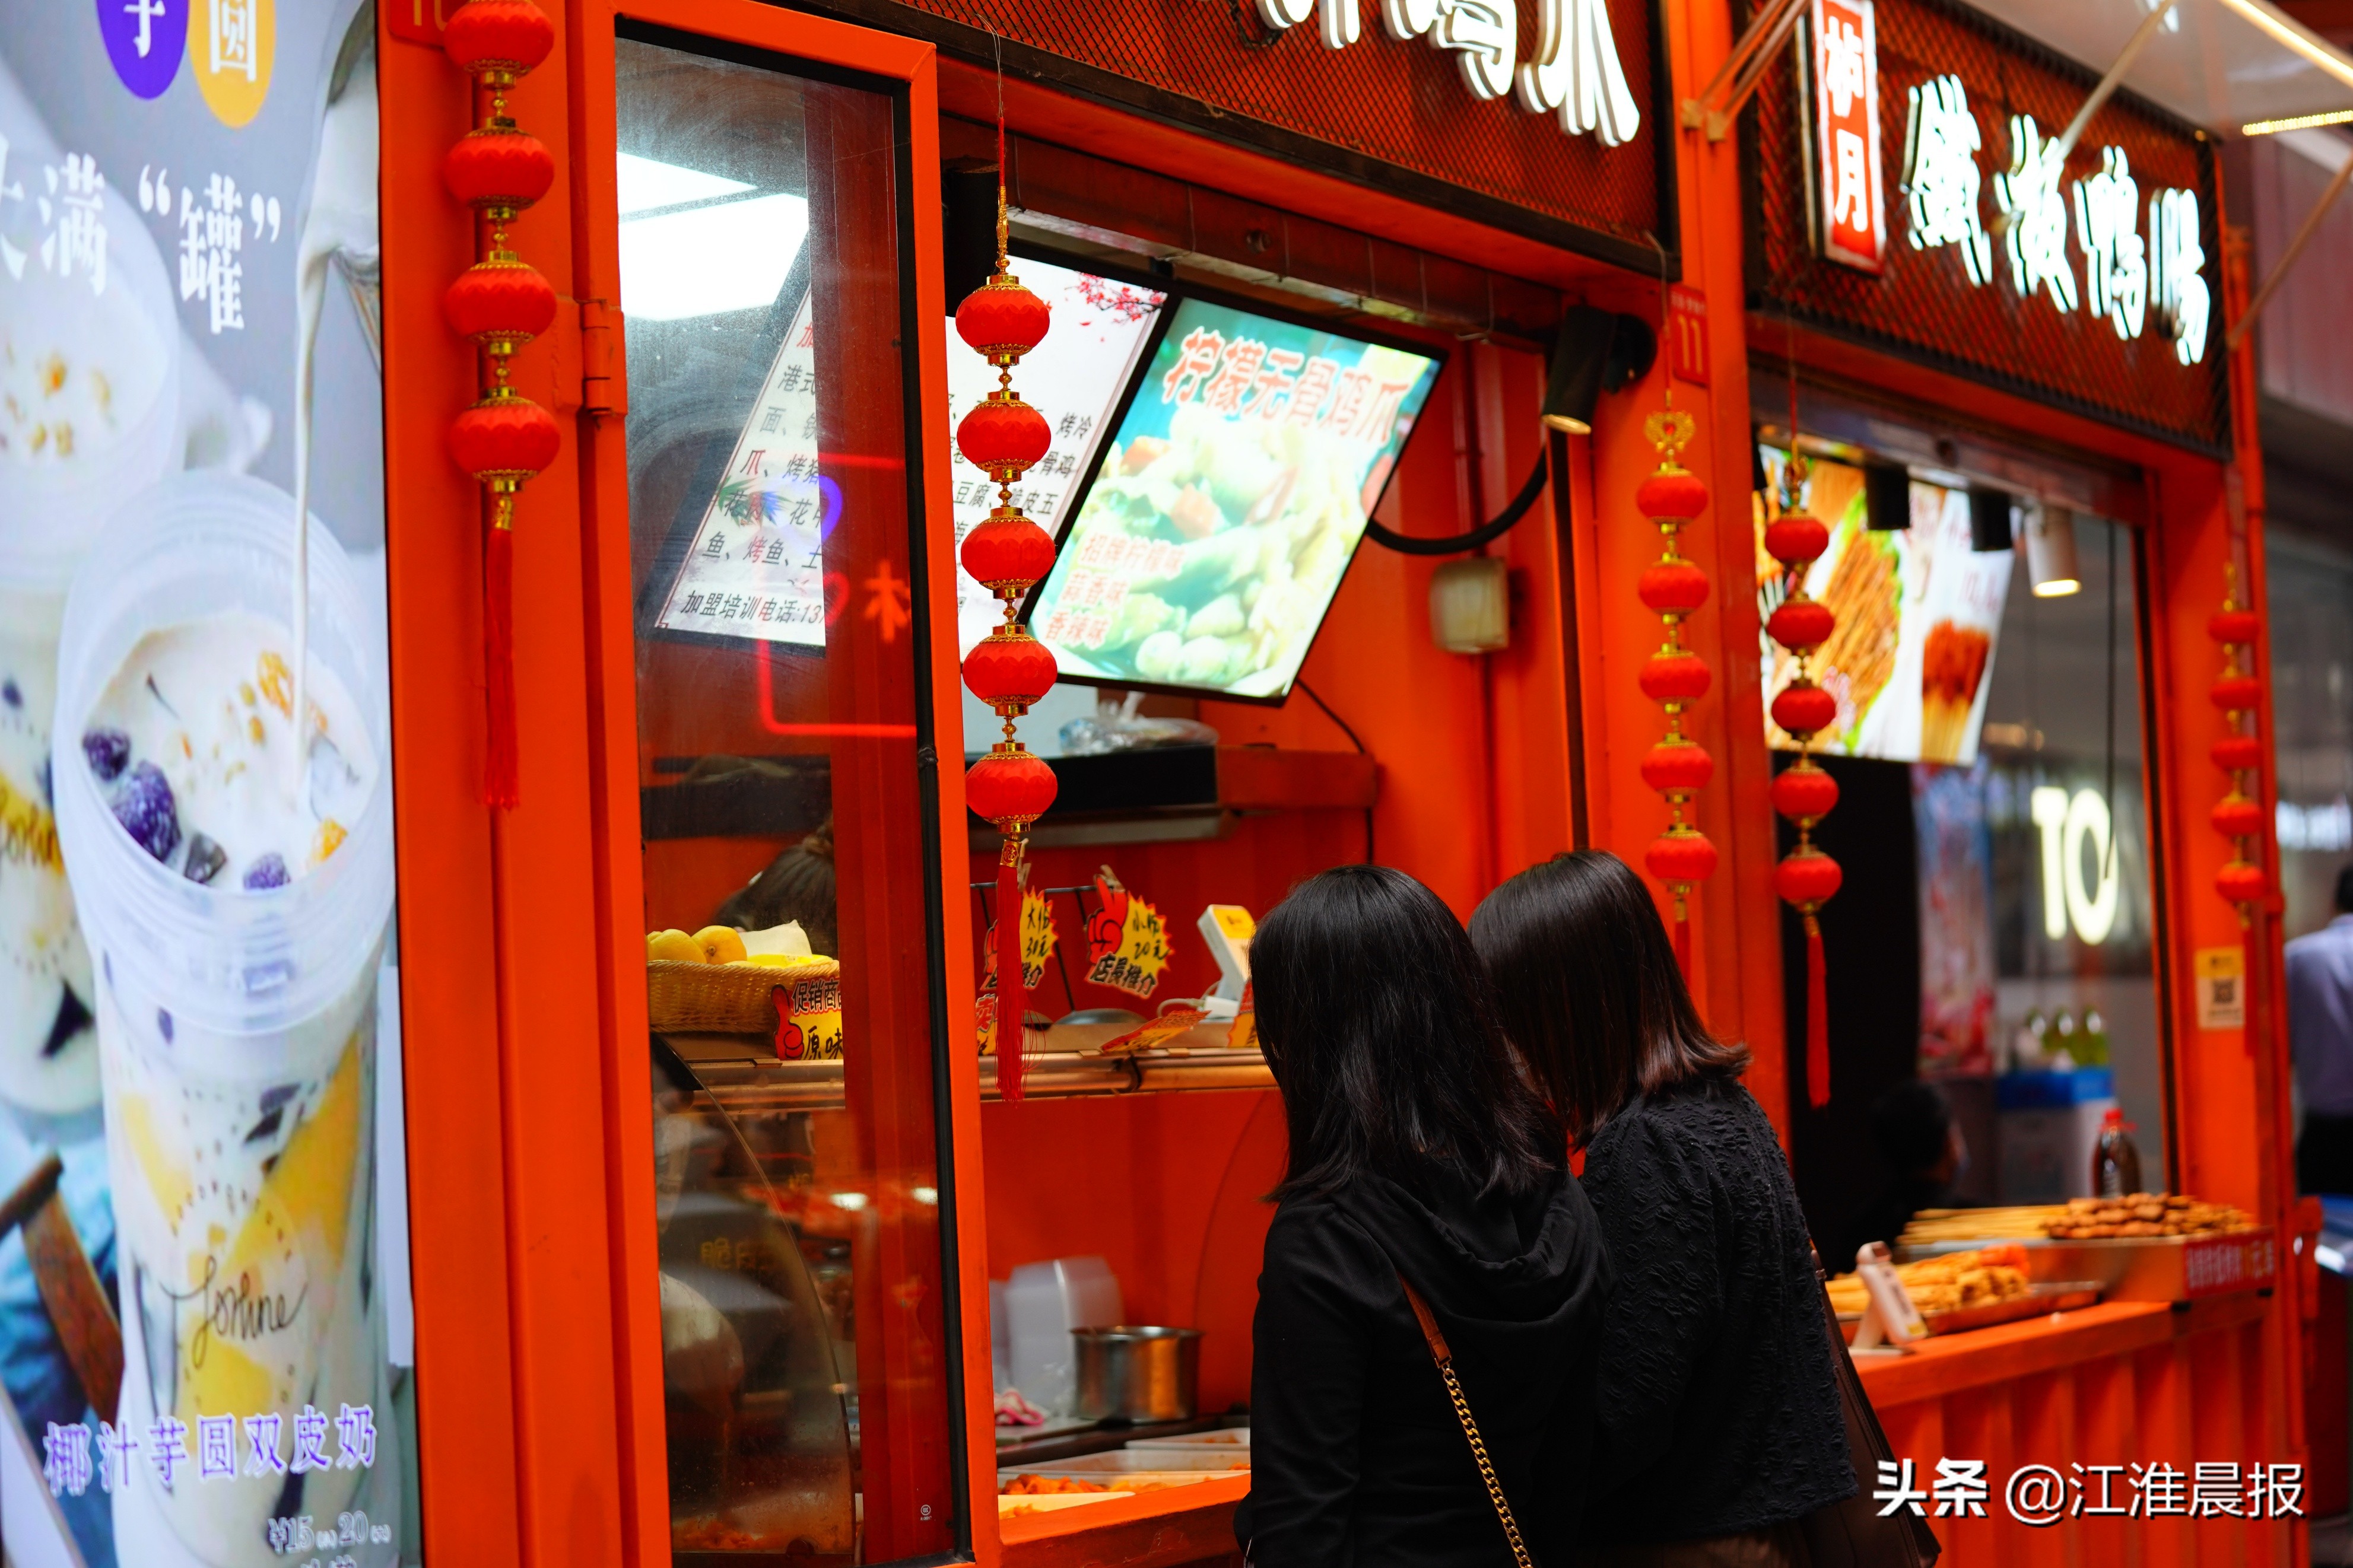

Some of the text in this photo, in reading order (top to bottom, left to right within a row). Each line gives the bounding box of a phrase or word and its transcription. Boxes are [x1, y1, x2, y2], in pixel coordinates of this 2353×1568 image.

[1677, 312, 1704, 375] 11
[1164, 326, 1411, 447] 柠檬无骨鸡爪
[1029, 451, 1076, 479] 骨鸡
[804, 1025, 843, 1060] 原味
[43, 1402, 378, 1497] 椰汁芋圆双皮奶
